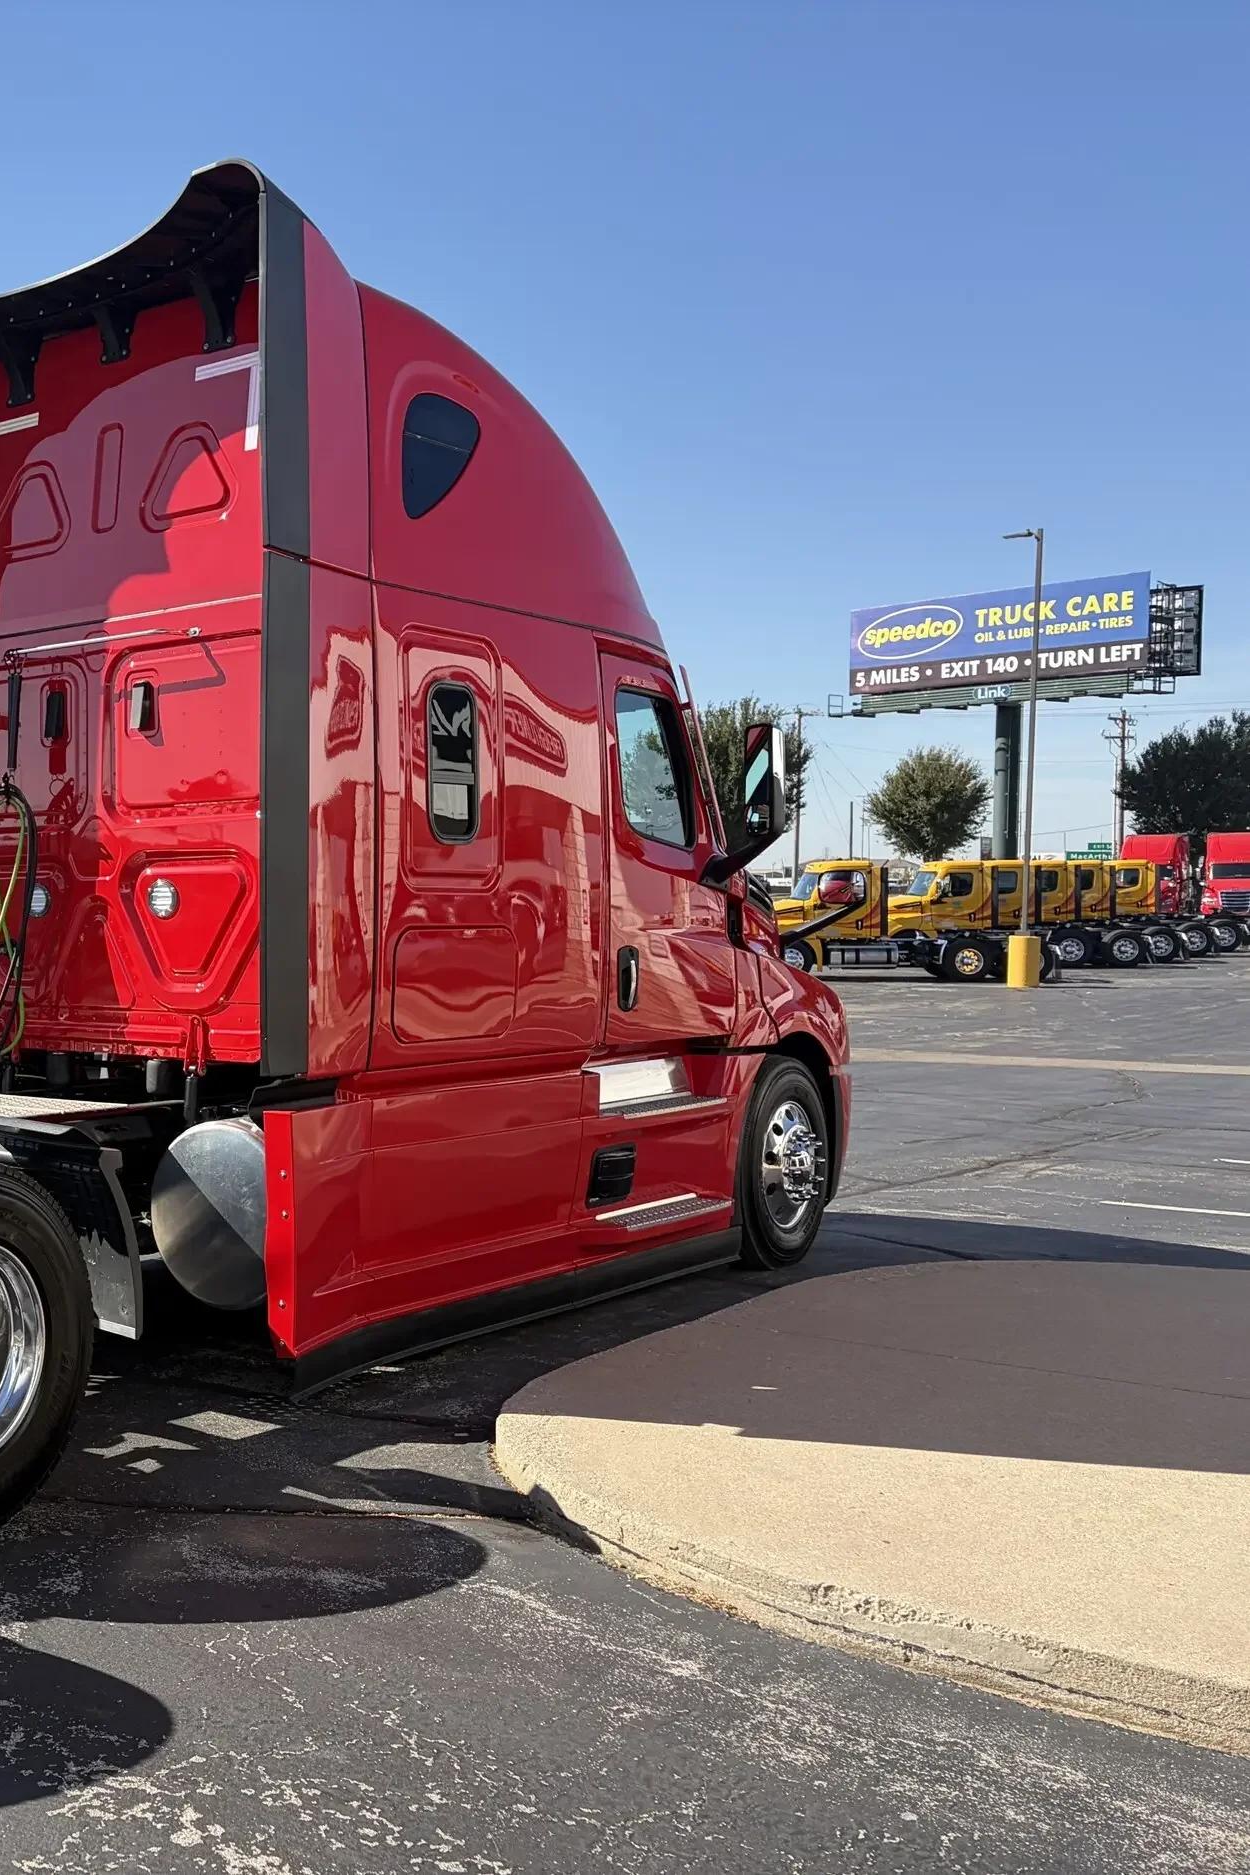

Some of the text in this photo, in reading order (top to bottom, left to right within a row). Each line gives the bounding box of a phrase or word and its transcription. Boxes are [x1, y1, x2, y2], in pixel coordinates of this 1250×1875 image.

[974, 590, 1134, 628] TRUCK CARE
[864, 617, 957, 648] speedco
[974, 631, 994, 644] OIL
[996, 630, 1006, 641] &
[1045, 621, 1091, 636] REPAIR
[1099, 615, 1134, 630] TIRES
[855, 642, 1144, 687] 5 MILES EXIT 140 TURN LEFT
